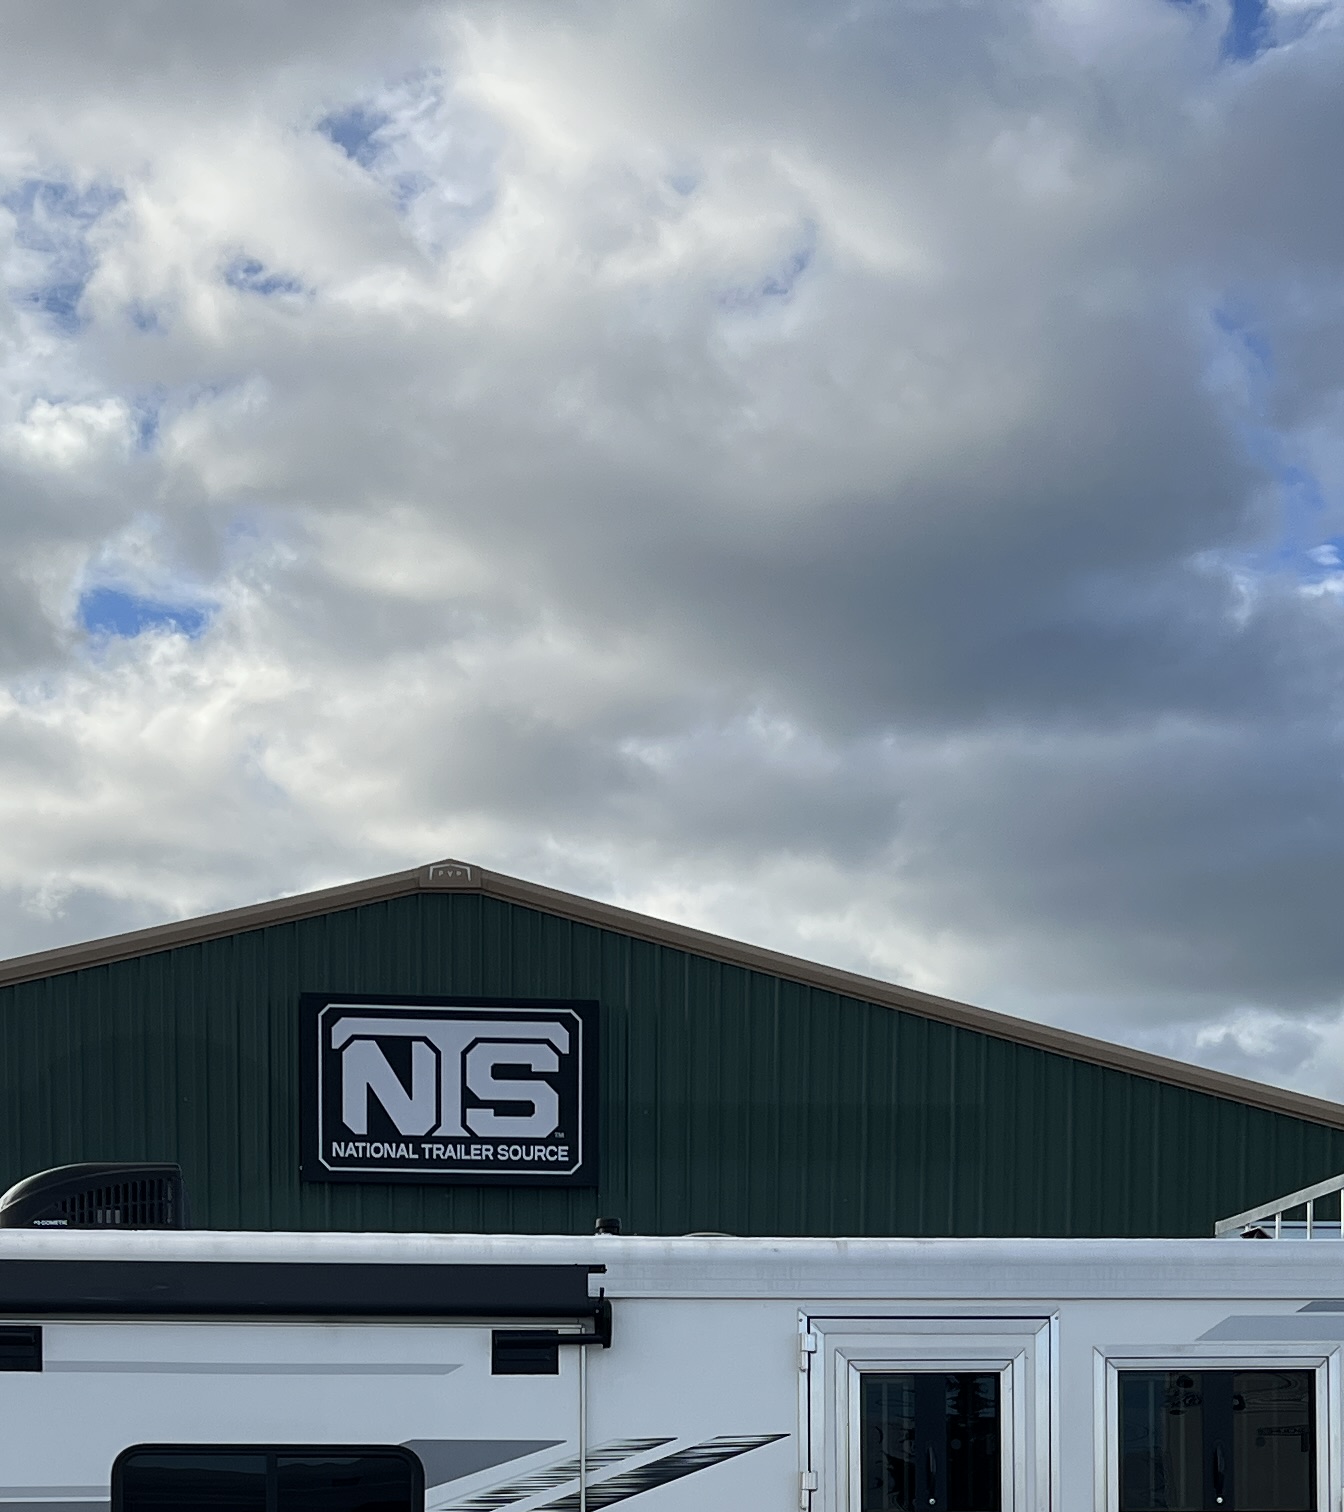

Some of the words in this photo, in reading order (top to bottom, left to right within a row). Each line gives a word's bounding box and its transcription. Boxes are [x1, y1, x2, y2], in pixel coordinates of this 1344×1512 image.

[331, 1017, 570, 1139] NTS
[331, 1141, 419, 1160] NATIONAL
[421, 1143, 494, 1161] TRAILER
[497, 1144, 569, 1162] SOURCE
